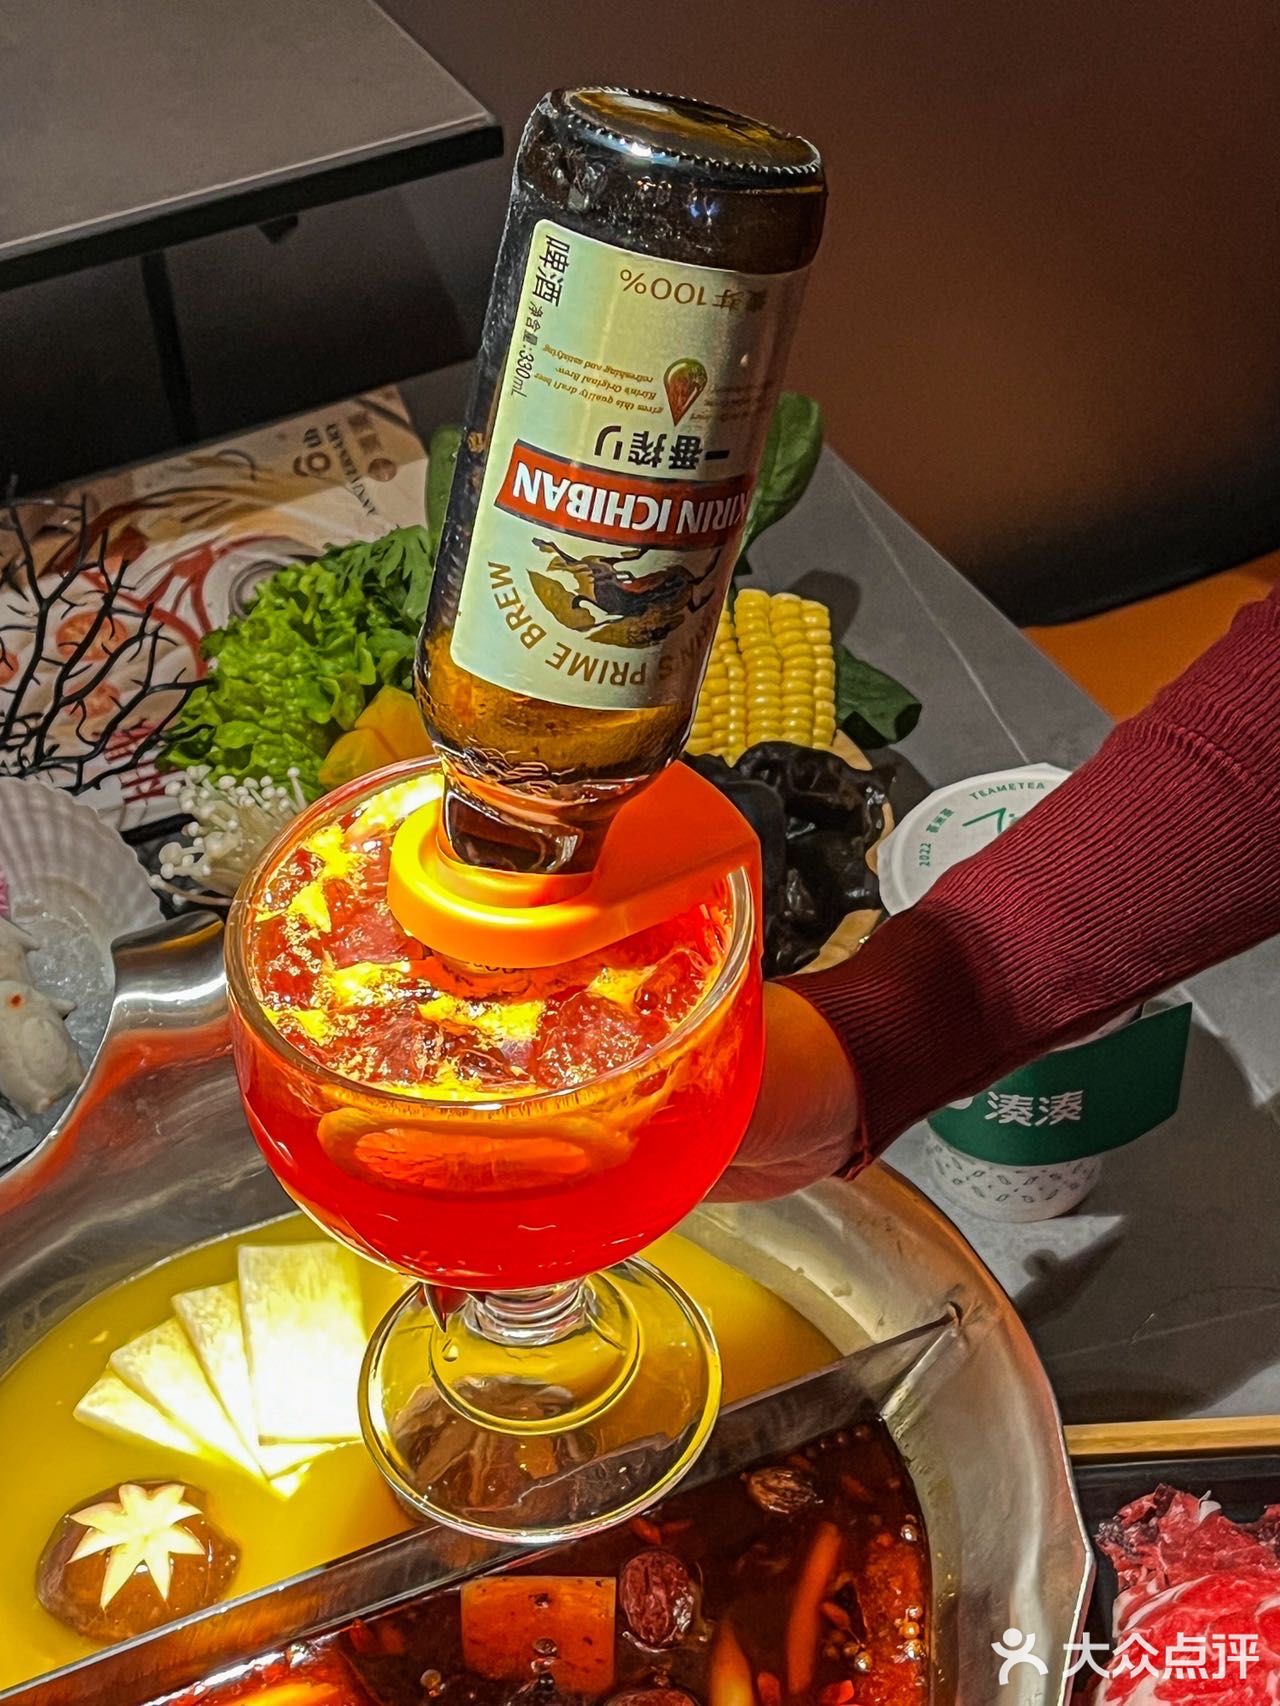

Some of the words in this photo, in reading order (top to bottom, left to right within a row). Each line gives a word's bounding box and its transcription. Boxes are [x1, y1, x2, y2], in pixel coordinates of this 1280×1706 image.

[532, 234, 570, 307] 啤酒
[583, 360, 602, 371] and
[553, 382, 578, 394] draft
[583, 376, 623, 393] Original
[579, 390, 614, 404] quality
[615, 399, 635, 410] this
[512, 462, 673, 532] ICHIBAN
[675, 489, 752, 535] KIRIN
[488, 561, 547, 650] BREW
[545, 641, 648, 687] PRIME
[969, 782, 1046, 800] TEAMETEA
[918, 842, 932, 868] 2022
